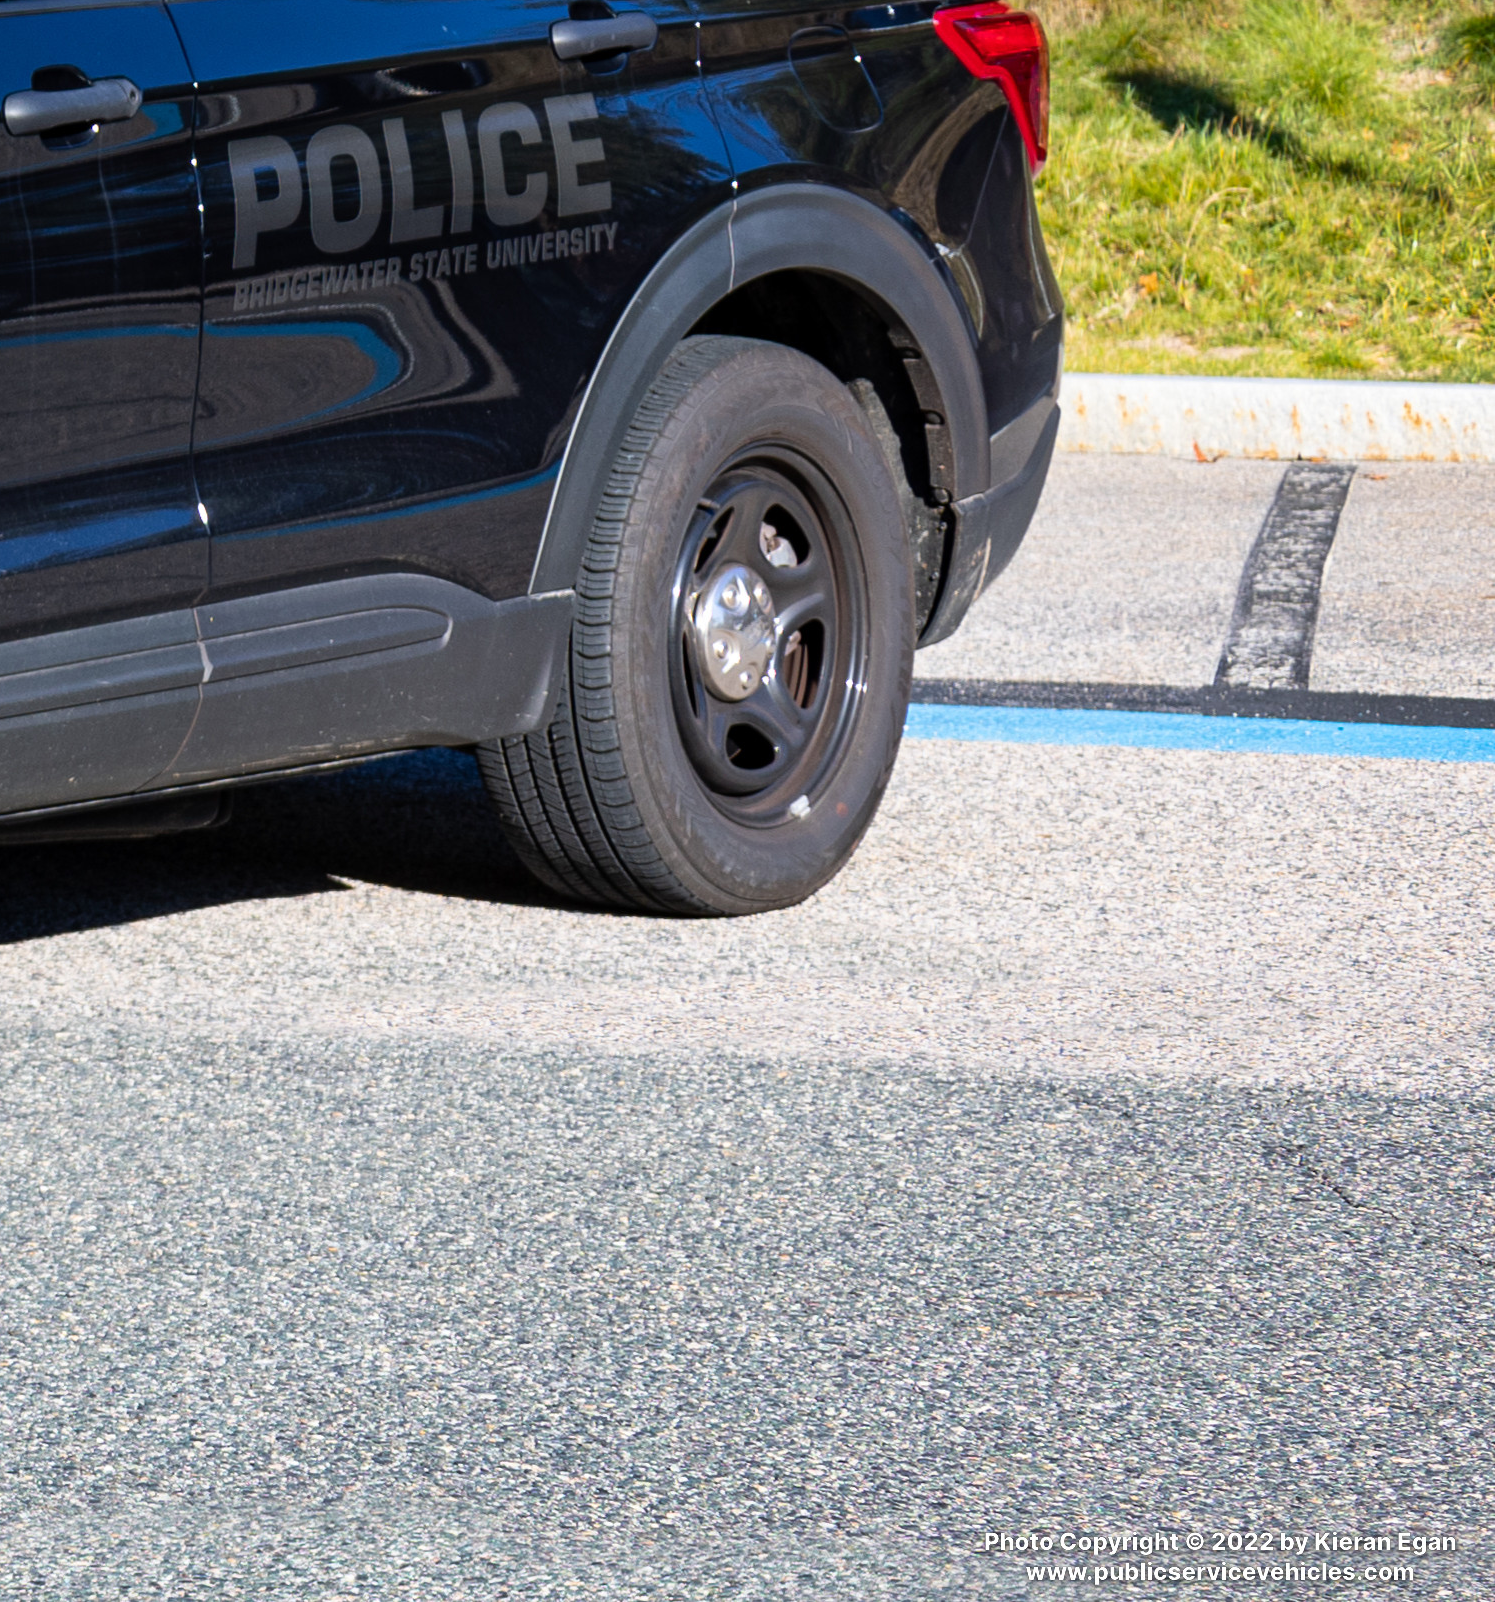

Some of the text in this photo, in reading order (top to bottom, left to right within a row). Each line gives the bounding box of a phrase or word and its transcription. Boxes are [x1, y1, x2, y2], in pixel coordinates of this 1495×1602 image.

[227, 92, 613, 270] POLICE
[232, 221, 620, 312] BRIDGEWATER STATE UNIVERSITY
